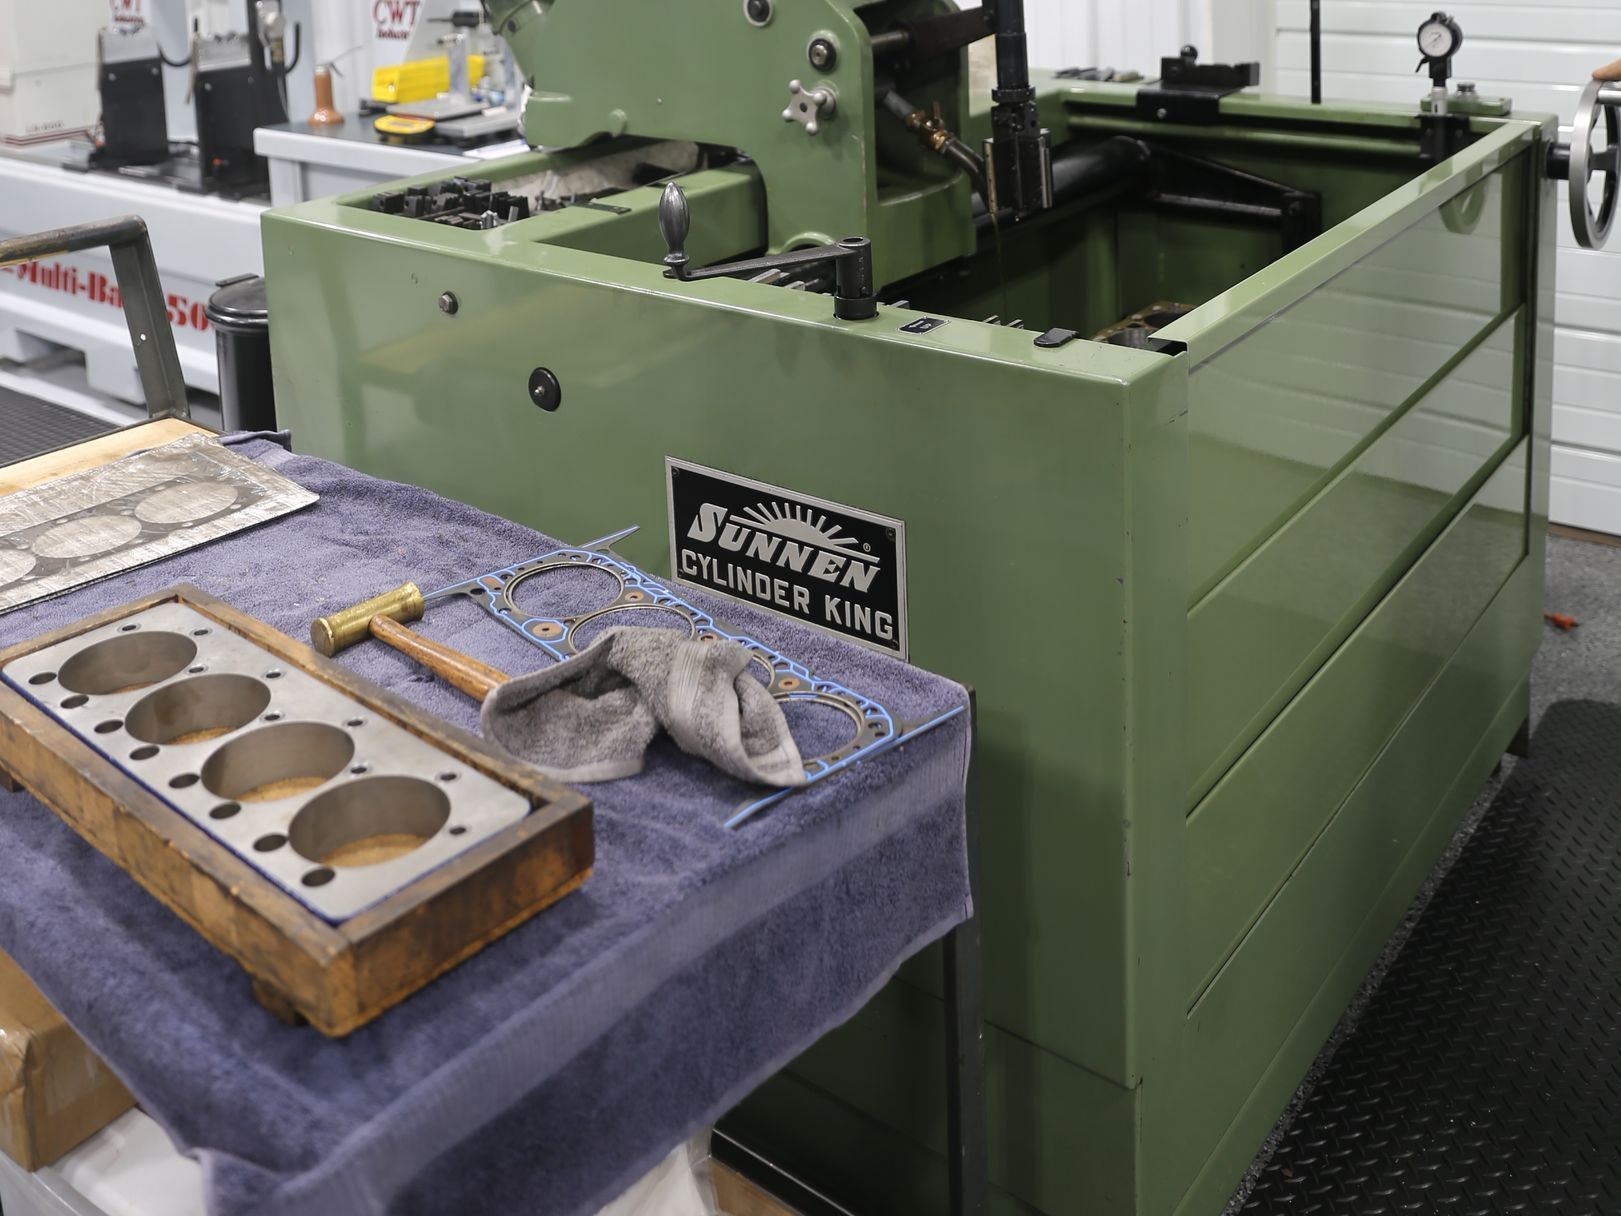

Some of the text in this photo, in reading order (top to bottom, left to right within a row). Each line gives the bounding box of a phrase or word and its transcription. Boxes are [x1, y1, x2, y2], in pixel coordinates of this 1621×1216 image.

[17, 261, 209, 330] Multi-Ba 50
[687, 502, 881, 593] SUNNEN
[681, 548, 893, 640] CYLINDER KING
